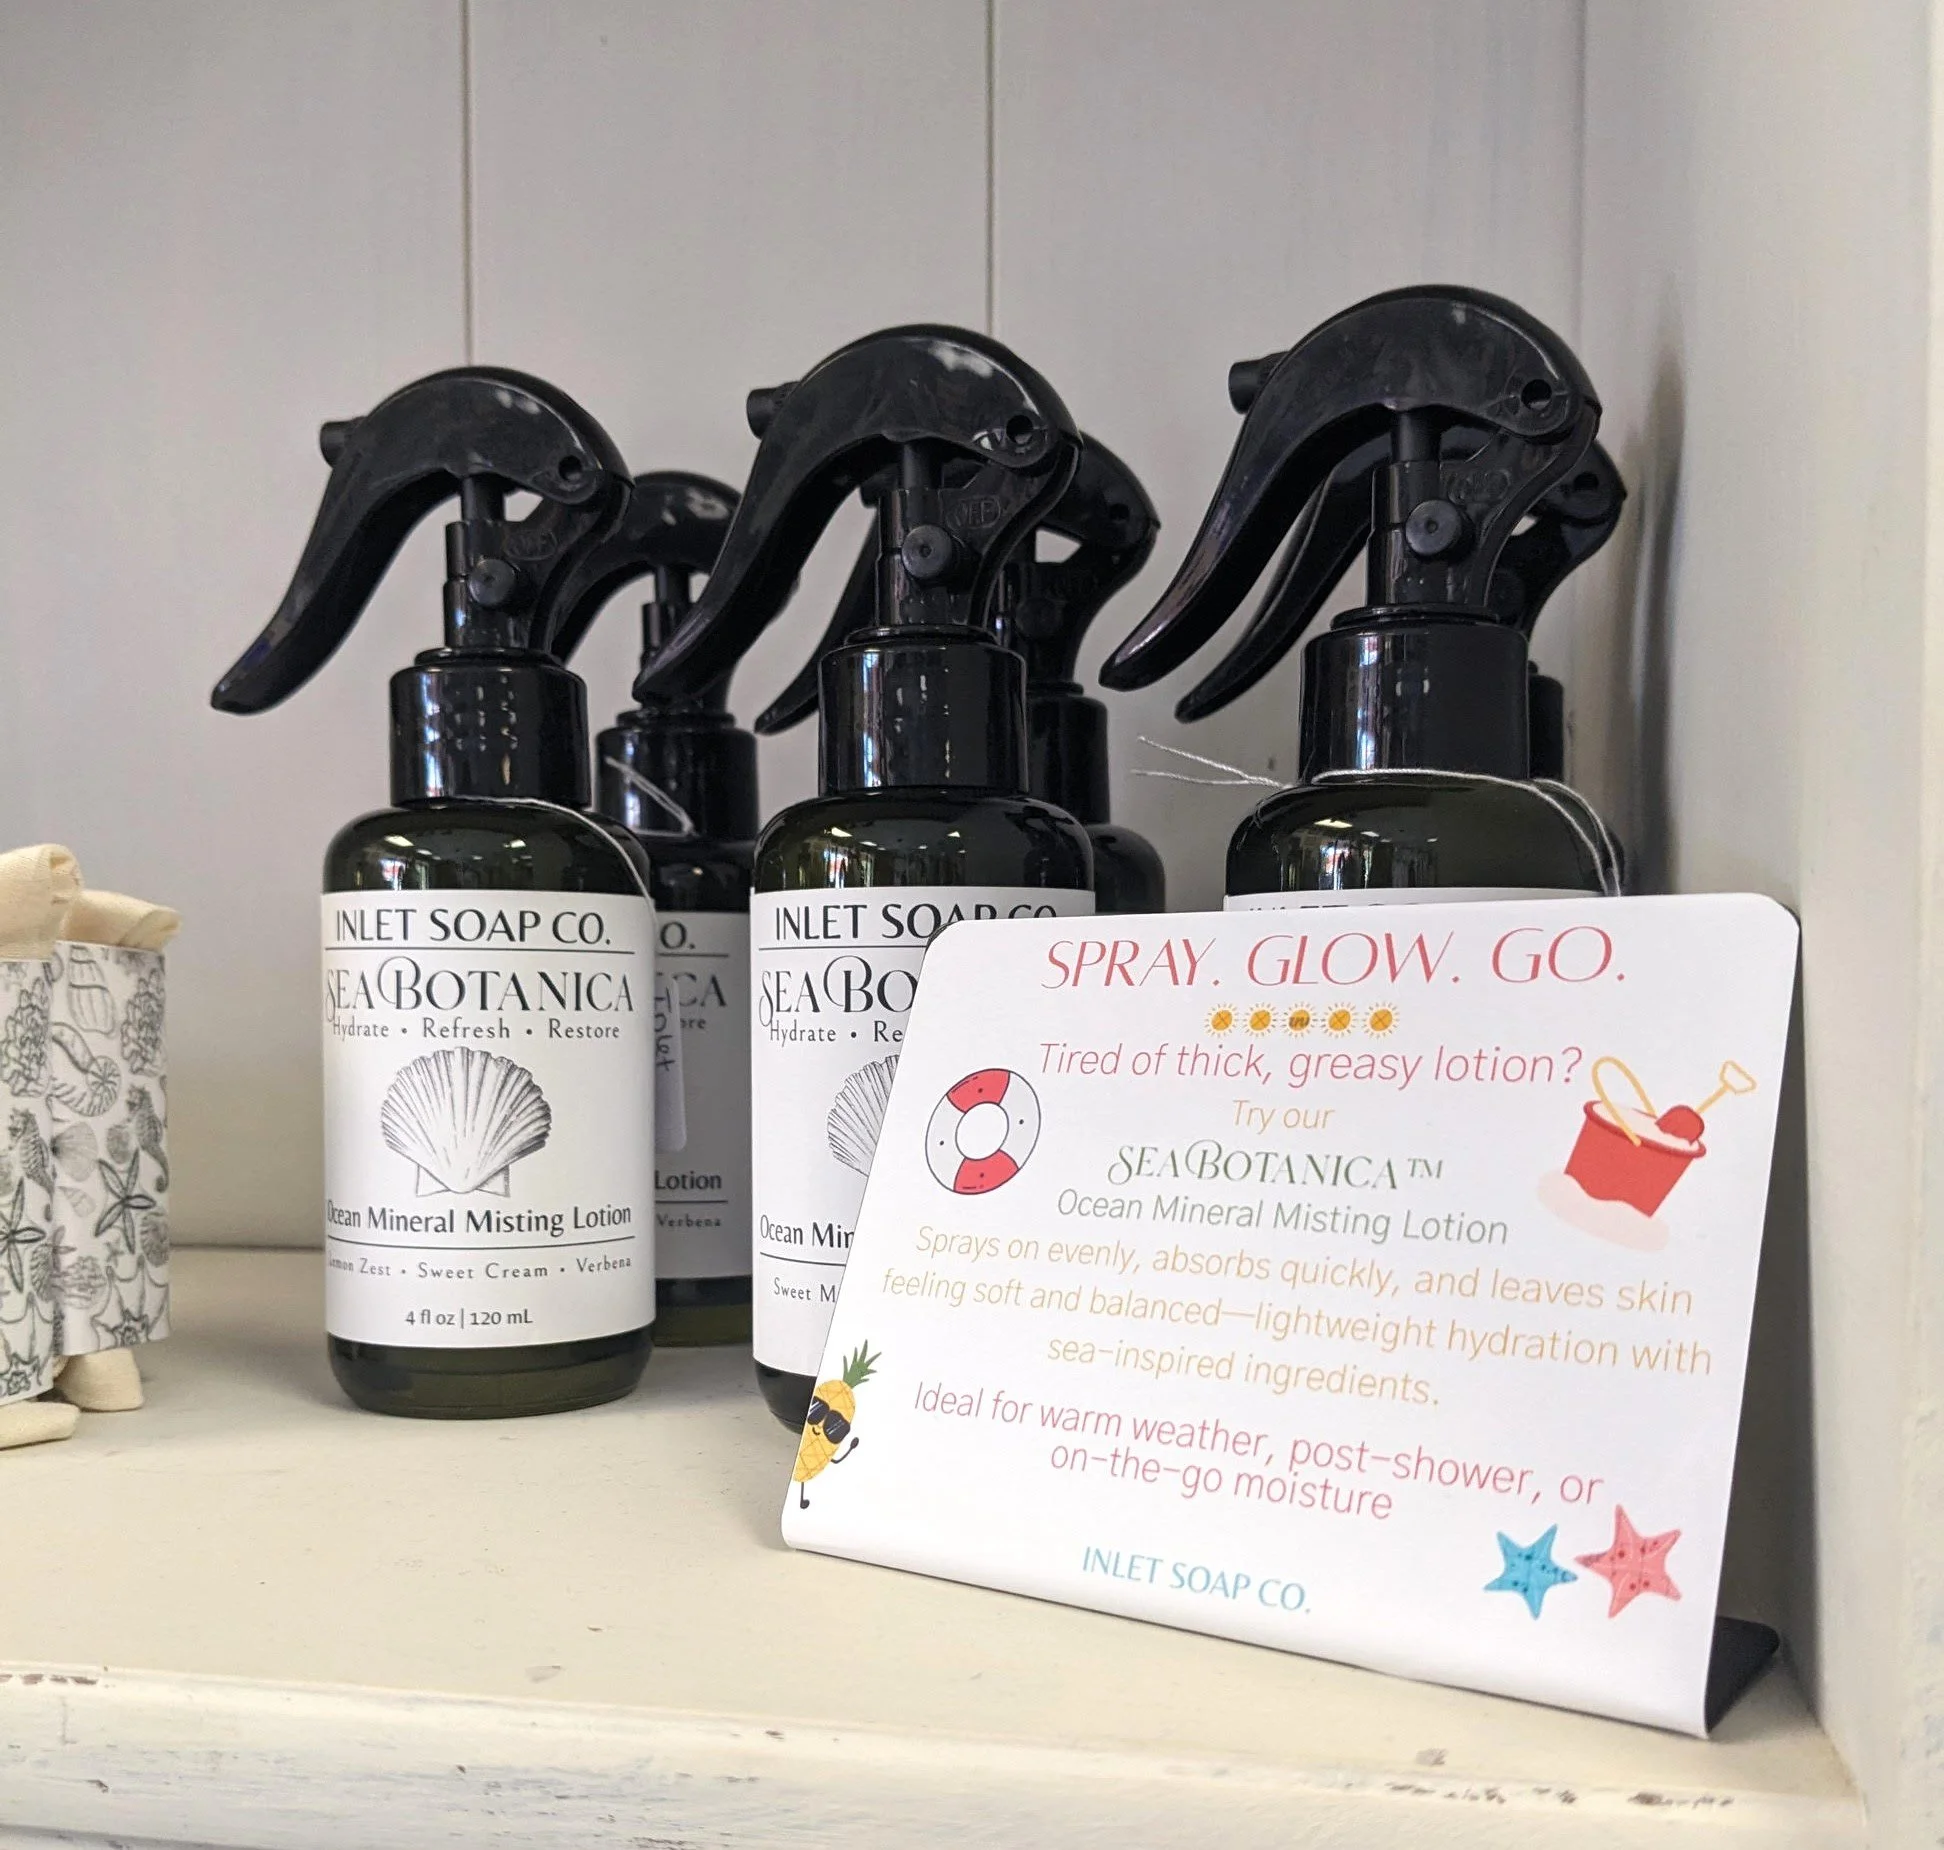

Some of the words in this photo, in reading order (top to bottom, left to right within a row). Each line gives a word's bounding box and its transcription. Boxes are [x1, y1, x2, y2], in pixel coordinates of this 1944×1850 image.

[336, 908, 418, 942] INLET
[430, 909, 541, 942] SOAP
[552, 912, 610, 945] CO.
[660, 921, 695, 950] O.
[776, 905, 867, 941] INLET
[1041, 938, 1220, 989] SPRAY.
[1248, 931, 1460, 986] GLOW.
[1492, 926, 1625, 983] GO.
[333, 1016, 389, 1041] Hydrate
[422, 1016, 510, 1038] Refresh
[549, 1018, 619, 1038] Restore
[770, 1020, 836, 1047] Hydrate
[1040, 1043, 1123, 1075] Tired
[1132, 1043, 1169, 1075] of
[1177, 1043, 1271, 1085] thick,
[1288, 1054, 1423, 1091] greasy
[1435, 1045, 1582, 1084] lotion?
[1233, 1100, 1275, 1134] Try
[1284, 1108, 1334, 1129] our
[655, 1169, 722, 1189] Lotion
[327, 1200, 362, 1229] Ocean
[368, 1206, 454, 1233] Mineral
[466, 1209, 564, 1238] Misting
[574, 1204, 631, 1229] Lotion
[760, 1214, 803, 1245] Ocean
[1058, 1189, 1142, 1219] Ocean
[1153, 1195, 1263, 1227] Mineral
[1273, 1202, 1390, 1244] Misting
[1403, 1210, 1507, 1244] Lotion
[360, 1258, 390, 1276] Zest
[418, 1262, 474, 1279] Sweet
[485, 1262, 547, 1279] Cream
[576, 1255, 630, 1273] Verbena
[916, 1226, 1000, 1262] Sprays
[1008, 1239, 1038, 1259] on
[1048, 1240, 1139, 1275] evenly,
[1153, 1245, 1270, 1279] absorbs
[1281, 1256, 1398, 1297] quickly,
[1415, 1268, 1479, 1297] and
[1491, 1268, 1603, 1307] leaves
[1617, 1280, 1692, 1315] skin
[774, 1277, 811, 1300] Sweet
[405, 1311, 415, 1325] 4
[435, 1314, 455, 1325] oz
[470, 1312, 501, 1325] 120
[507, 1309, 533, 1324] mL
[883, 1268, 966, 1307] feeling
[973, 1279, 1024, 1306] soft
[1031, 1286, 1082, 1311] and
[1448, 1320, 1618, 1366] hydration
[1633, 1339, 1710, 1374] with
[1245, 1354, 1438, 1406] ingredients.
[915, 1381, 983, 1417] Ideal
[992, 1390, 1033, 1424] for
[1041, 1405, 1121, 1437] warm
[1133, 1418, 1273, 1466] weather,
[1560, 1475, 1604, 1504] or
[1234, 1472, 1392, 1520] moisture
[1083, 1547, 1163, 1583] INLET
[1171, 1563, 1251, 1599] SOAP
[1258, 1580, 1310, 1613] CO.
